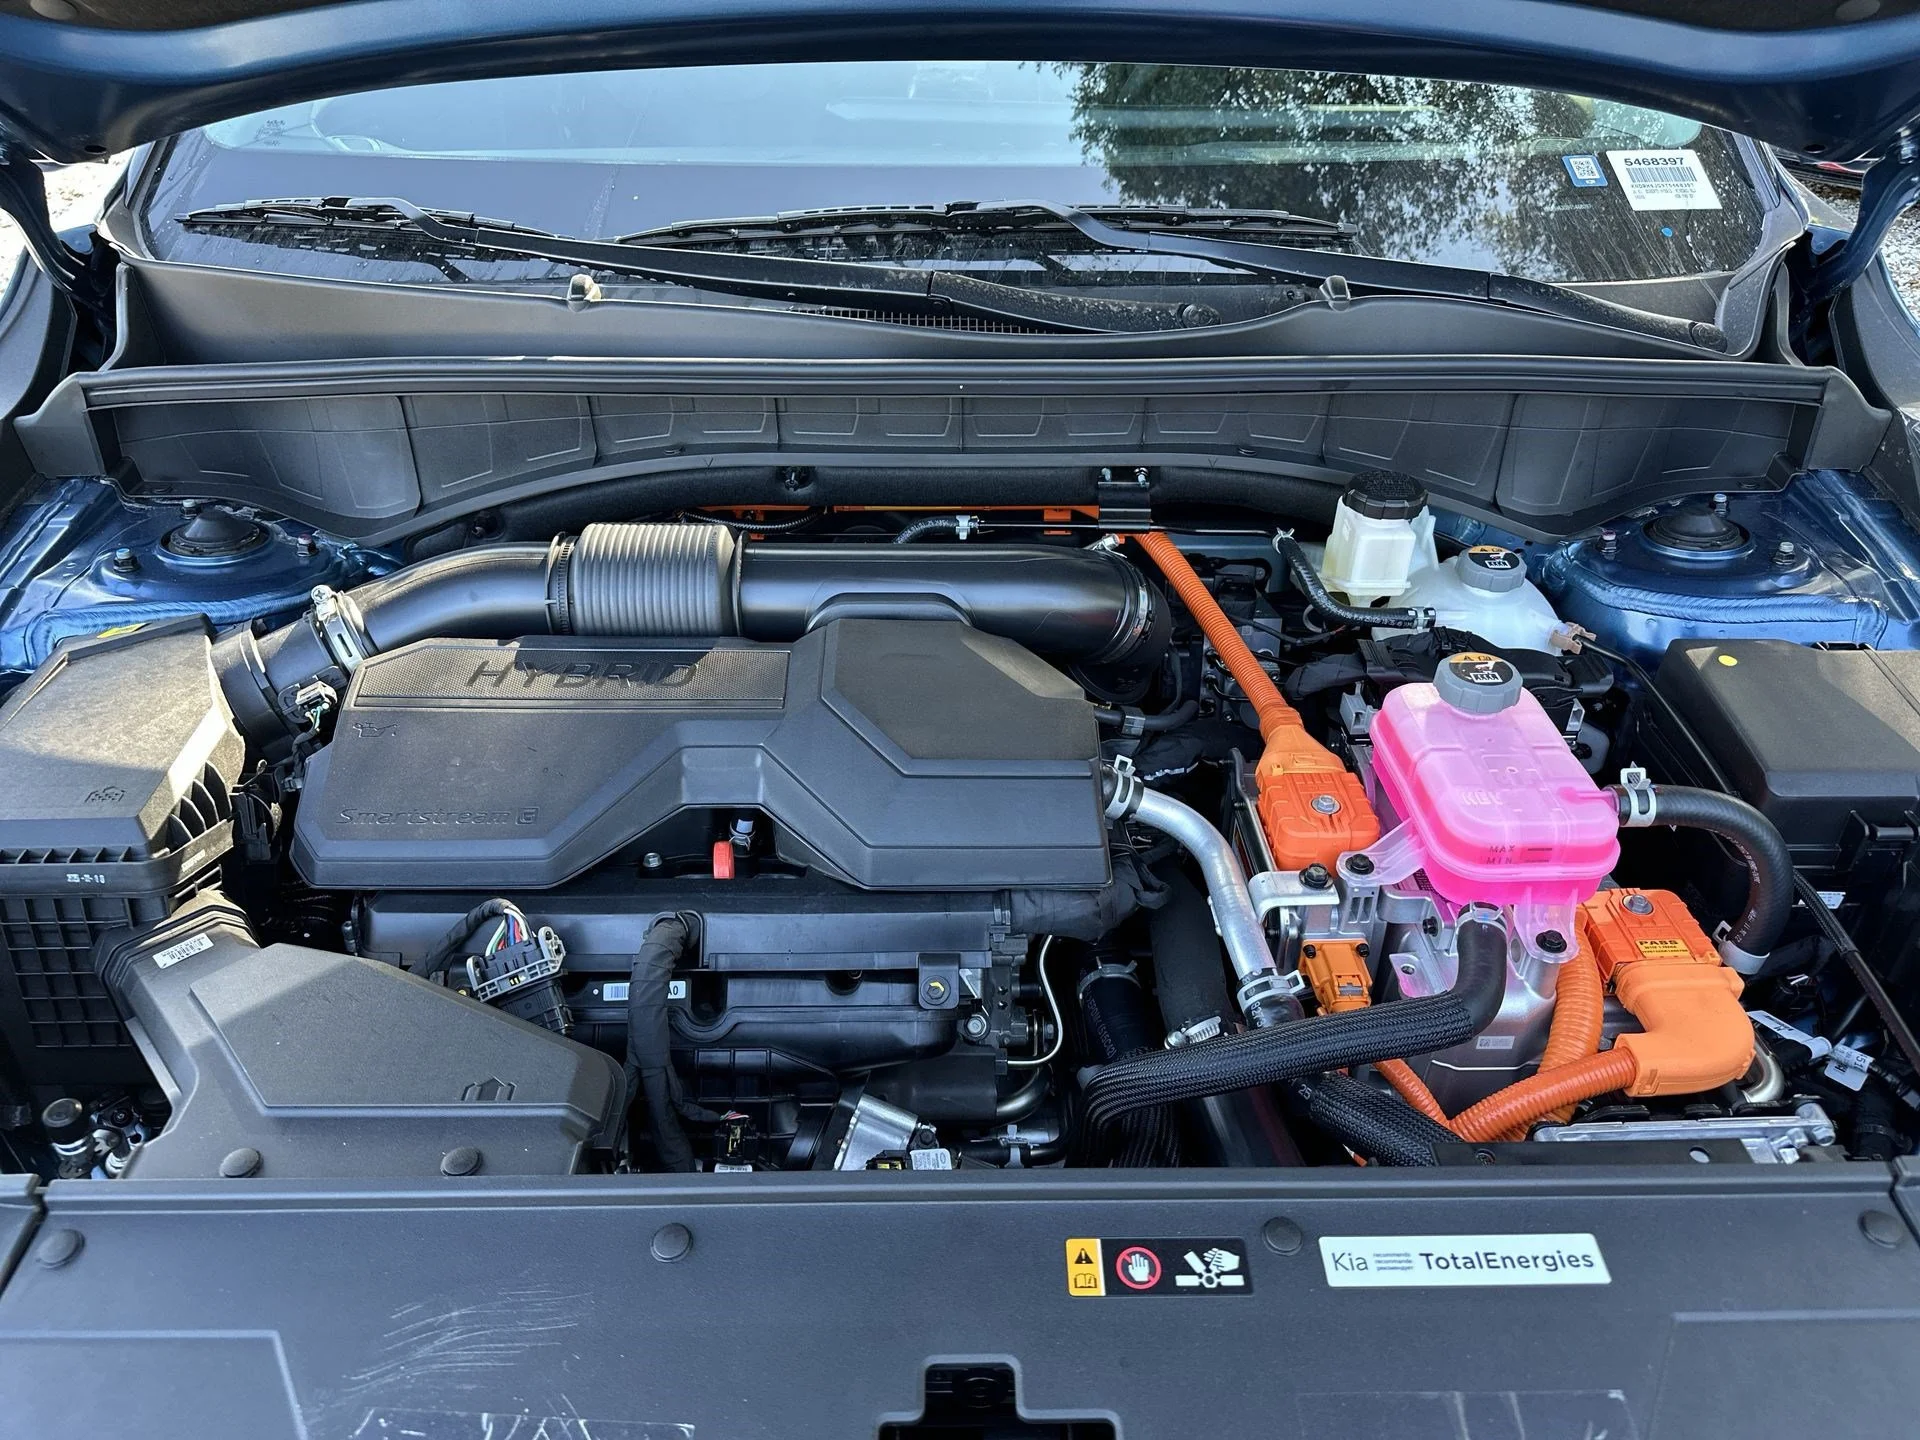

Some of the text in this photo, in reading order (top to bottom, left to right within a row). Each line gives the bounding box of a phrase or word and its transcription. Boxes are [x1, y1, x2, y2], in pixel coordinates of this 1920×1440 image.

[1624, 157, 1684, 166] 5468397
[466, 660, 699, 688] HYBRID
[336, 808, 510, 825] Smartstream
[1489, 844, 1515, 853] MAX
[1486, 857, 1512, 865] MIN
[1331, 1252, 1369, 1271] Kia
[1418, 1250, 1594, 1272] TotalEnergies
